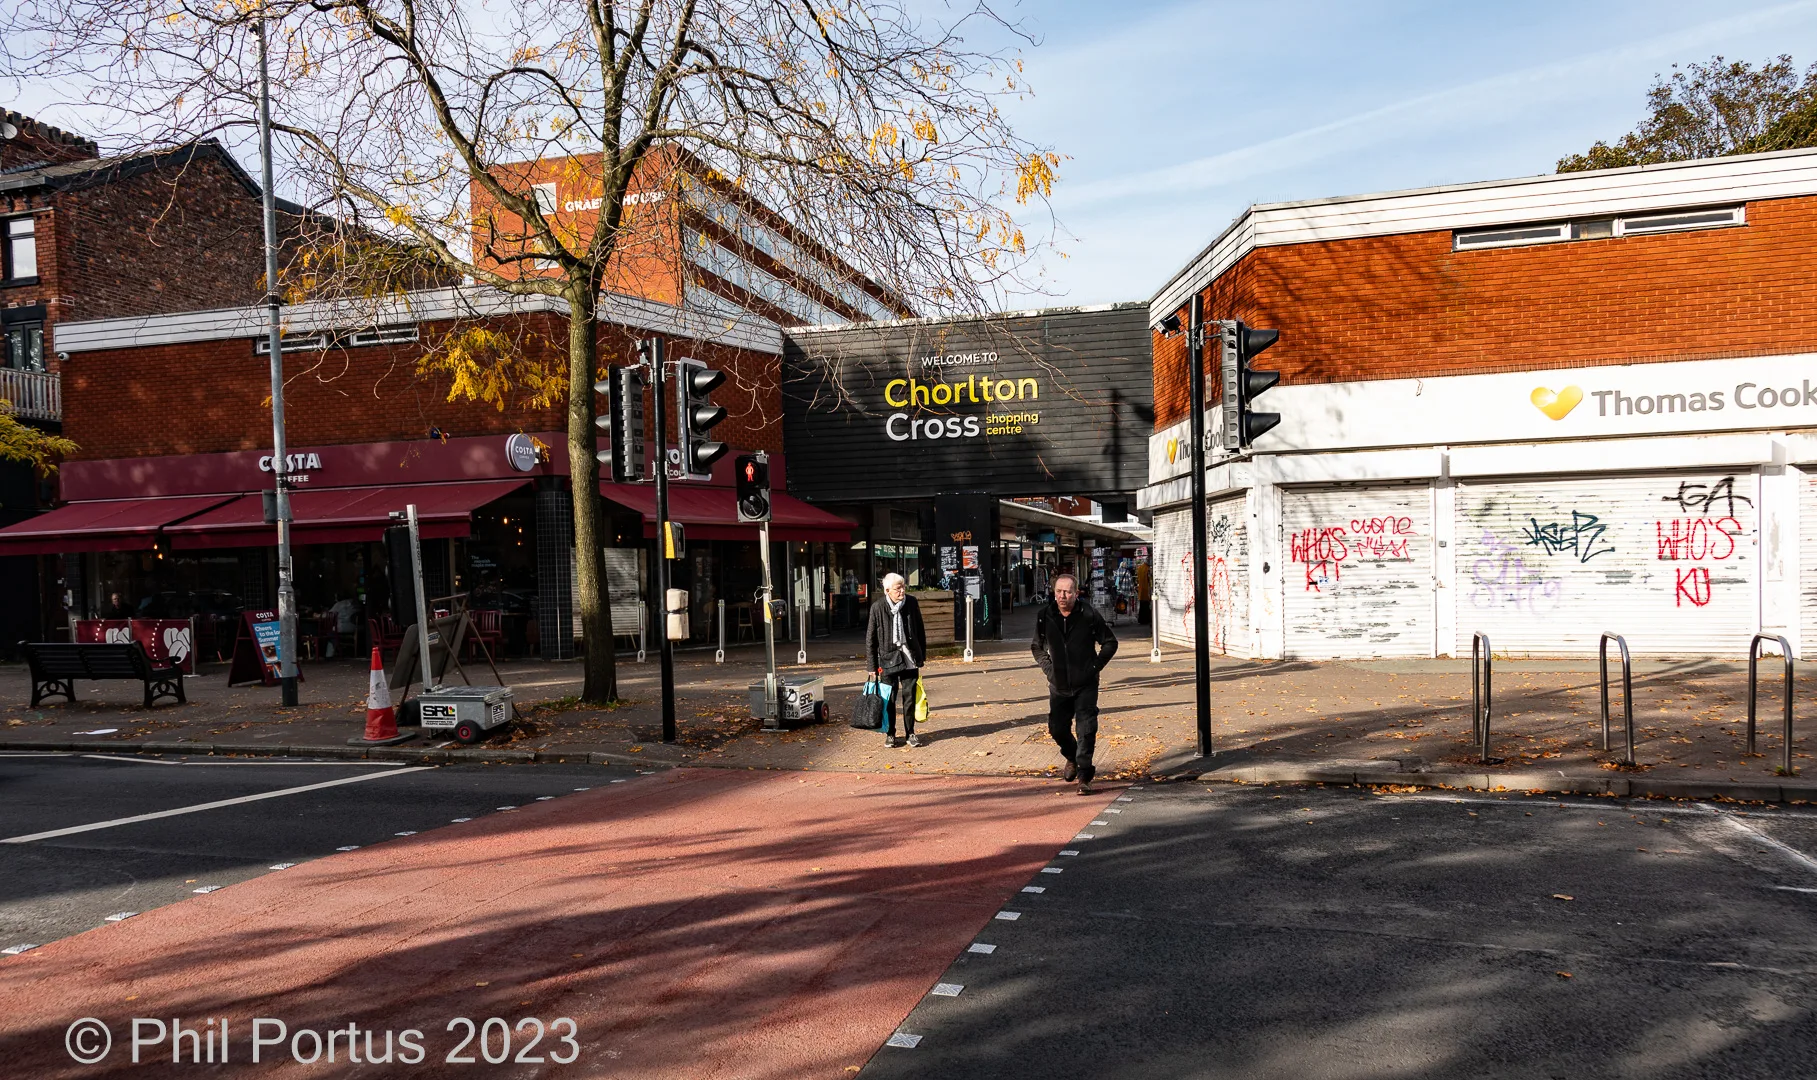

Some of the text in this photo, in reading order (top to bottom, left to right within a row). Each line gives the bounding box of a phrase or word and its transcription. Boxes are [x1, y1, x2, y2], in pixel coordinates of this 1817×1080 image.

[565, 198, 602, 212] GRAE
[921, 351, 999, 367] WELCOME TO
[884, 374, 1039, 407] Chorlton
[1591, 379, 1817, 417] Thomas Cook
[985, 412, 1039, 425] shopping
[885, 412, 980, 442] Cross
[986, 425, 1023, 436] centre
[515, 445, 534, 455] COSTA
[1179, 440, 1191, 460] Tho
[1655, 516, 1743, 561] WHO'S
[800, 692, 813, 706] SRL
[423, 706, 455, 716] SRL
